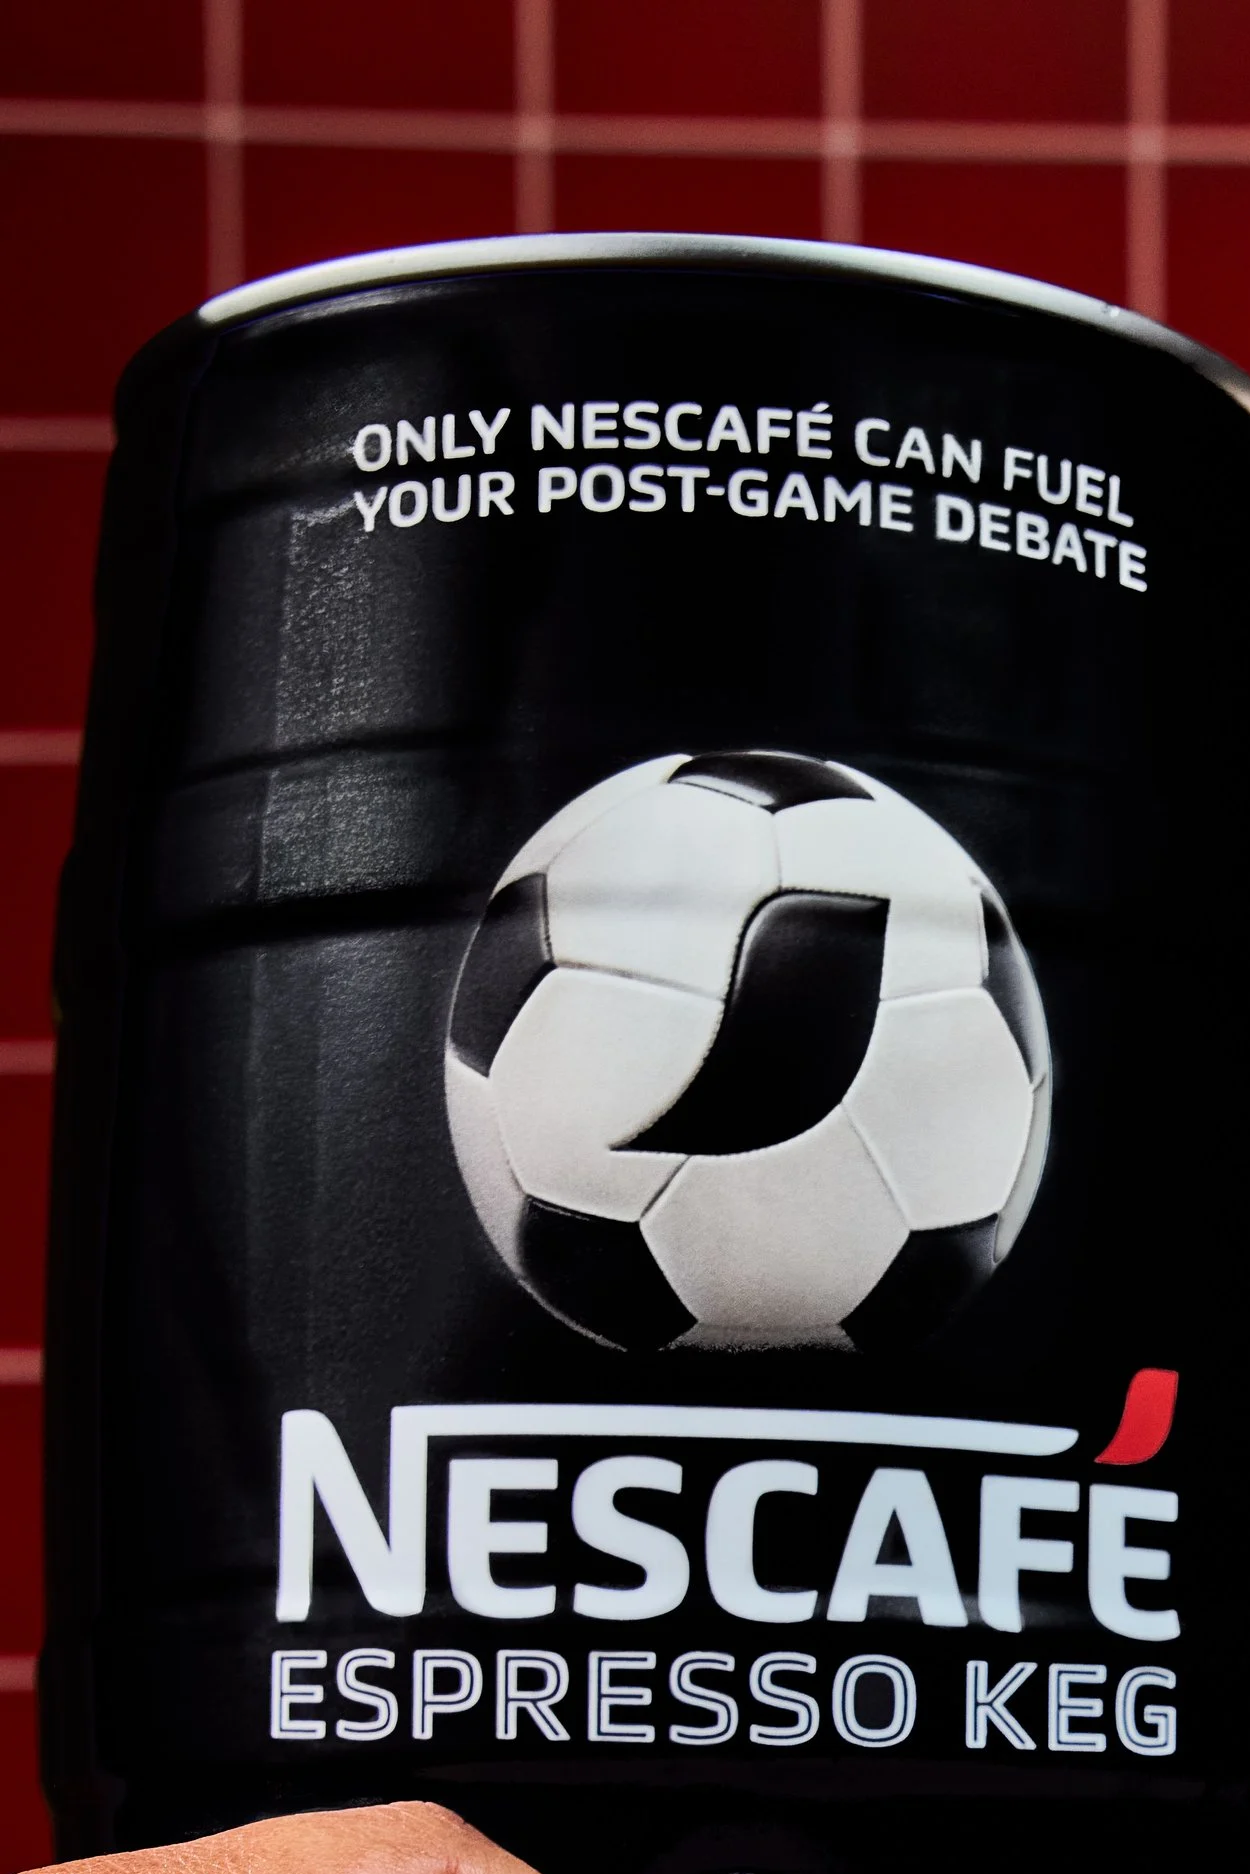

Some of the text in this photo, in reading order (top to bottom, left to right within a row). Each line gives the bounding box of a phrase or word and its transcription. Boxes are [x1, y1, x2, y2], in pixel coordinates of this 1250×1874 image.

[352, 402, 1135, 527] ONLY NESCAFÉ CAN FUEL
[355, 465, 1147, 592] YOUR POST-GAME DEBATE
[277, 1368, 1180, 1641] NESCAFÉ
[271, 1649, 1177, 1756] ESPRESSO KEG
